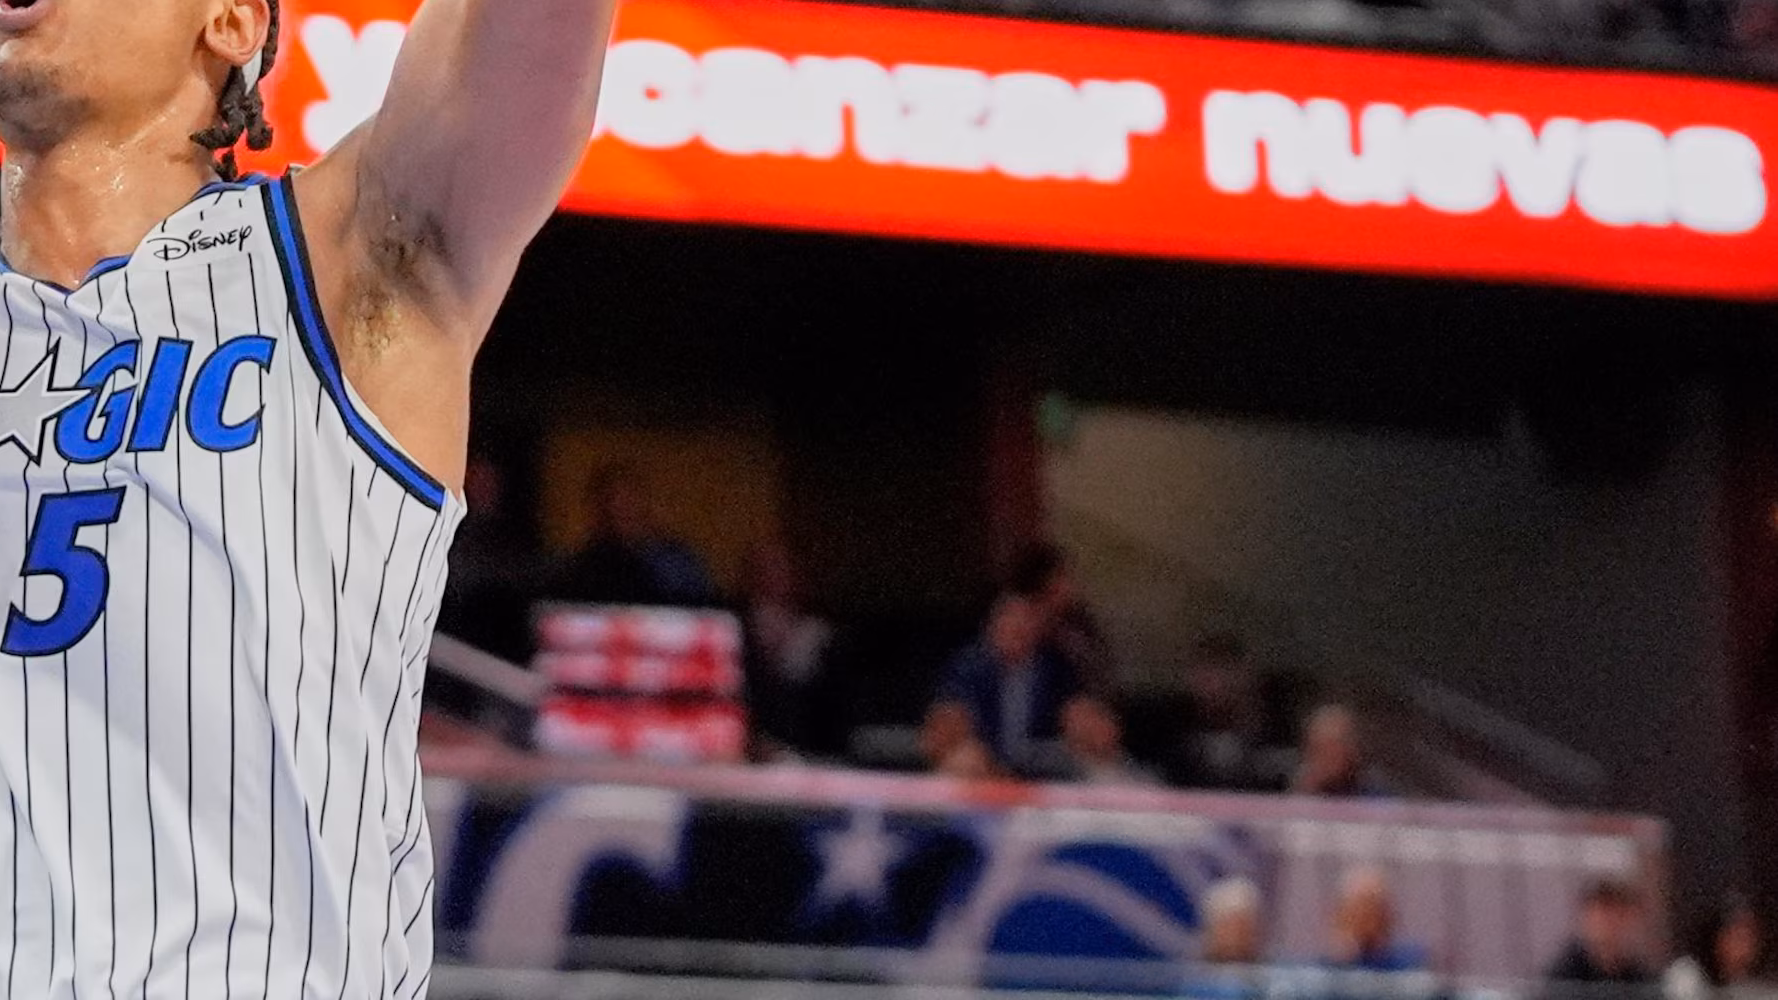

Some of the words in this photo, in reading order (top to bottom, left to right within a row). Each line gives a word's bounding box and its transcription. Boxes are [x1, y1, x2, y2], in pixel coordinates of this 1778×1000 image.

[590, 38, 1166, 183] canzar
[1203, 90, 1765, 235] nuevas
[0, 486, 127, 657] 5
